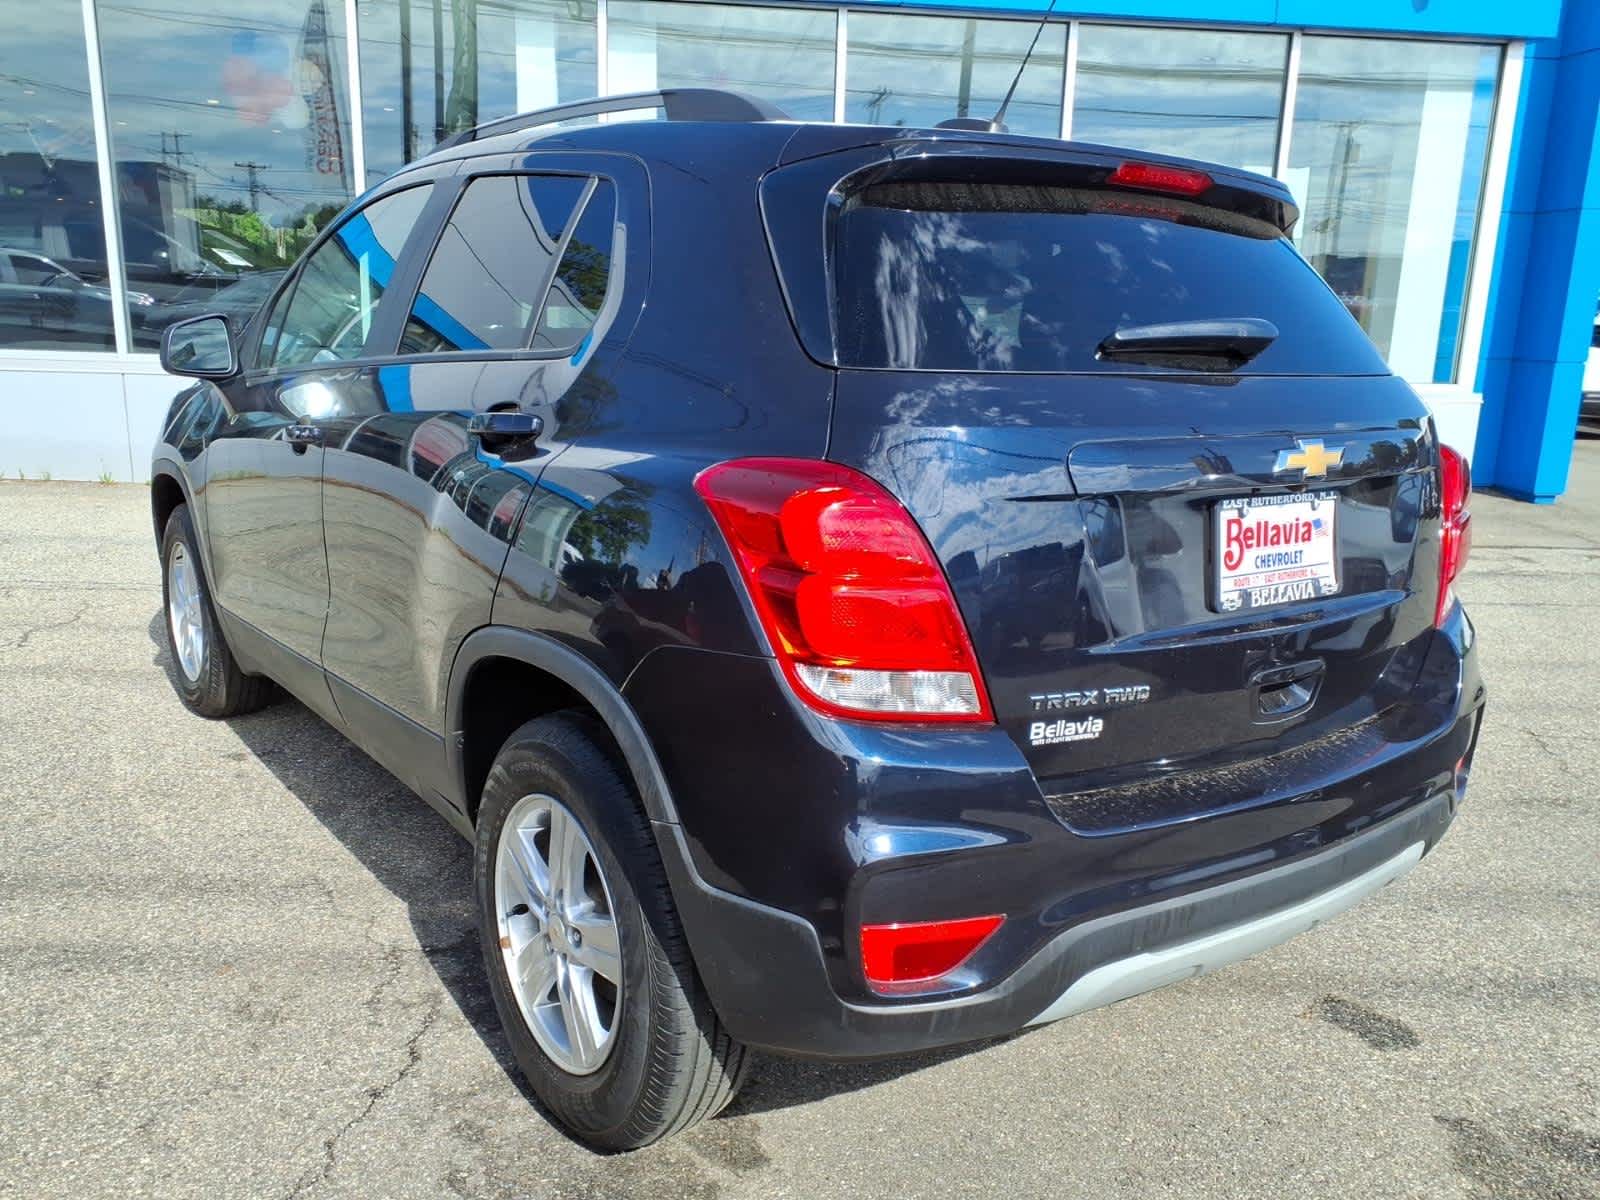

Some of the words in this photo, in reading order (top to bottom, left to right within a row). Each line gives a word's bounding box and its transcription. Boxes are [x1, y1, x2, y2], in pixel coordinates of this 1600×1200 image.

[1223, 498, 1249, 510] EAST
[1224, 517, 1312, 571] Bellavia
[1255, 550, 1303, 569] CHEVROLET
[1251, 581, 1315, 607] BELLAVIA
[1030, 690, 1098, 710] TRAX
[1103, 685, 1150, 703] AWD
[1030, 716, 1103, 739] Bellavia
